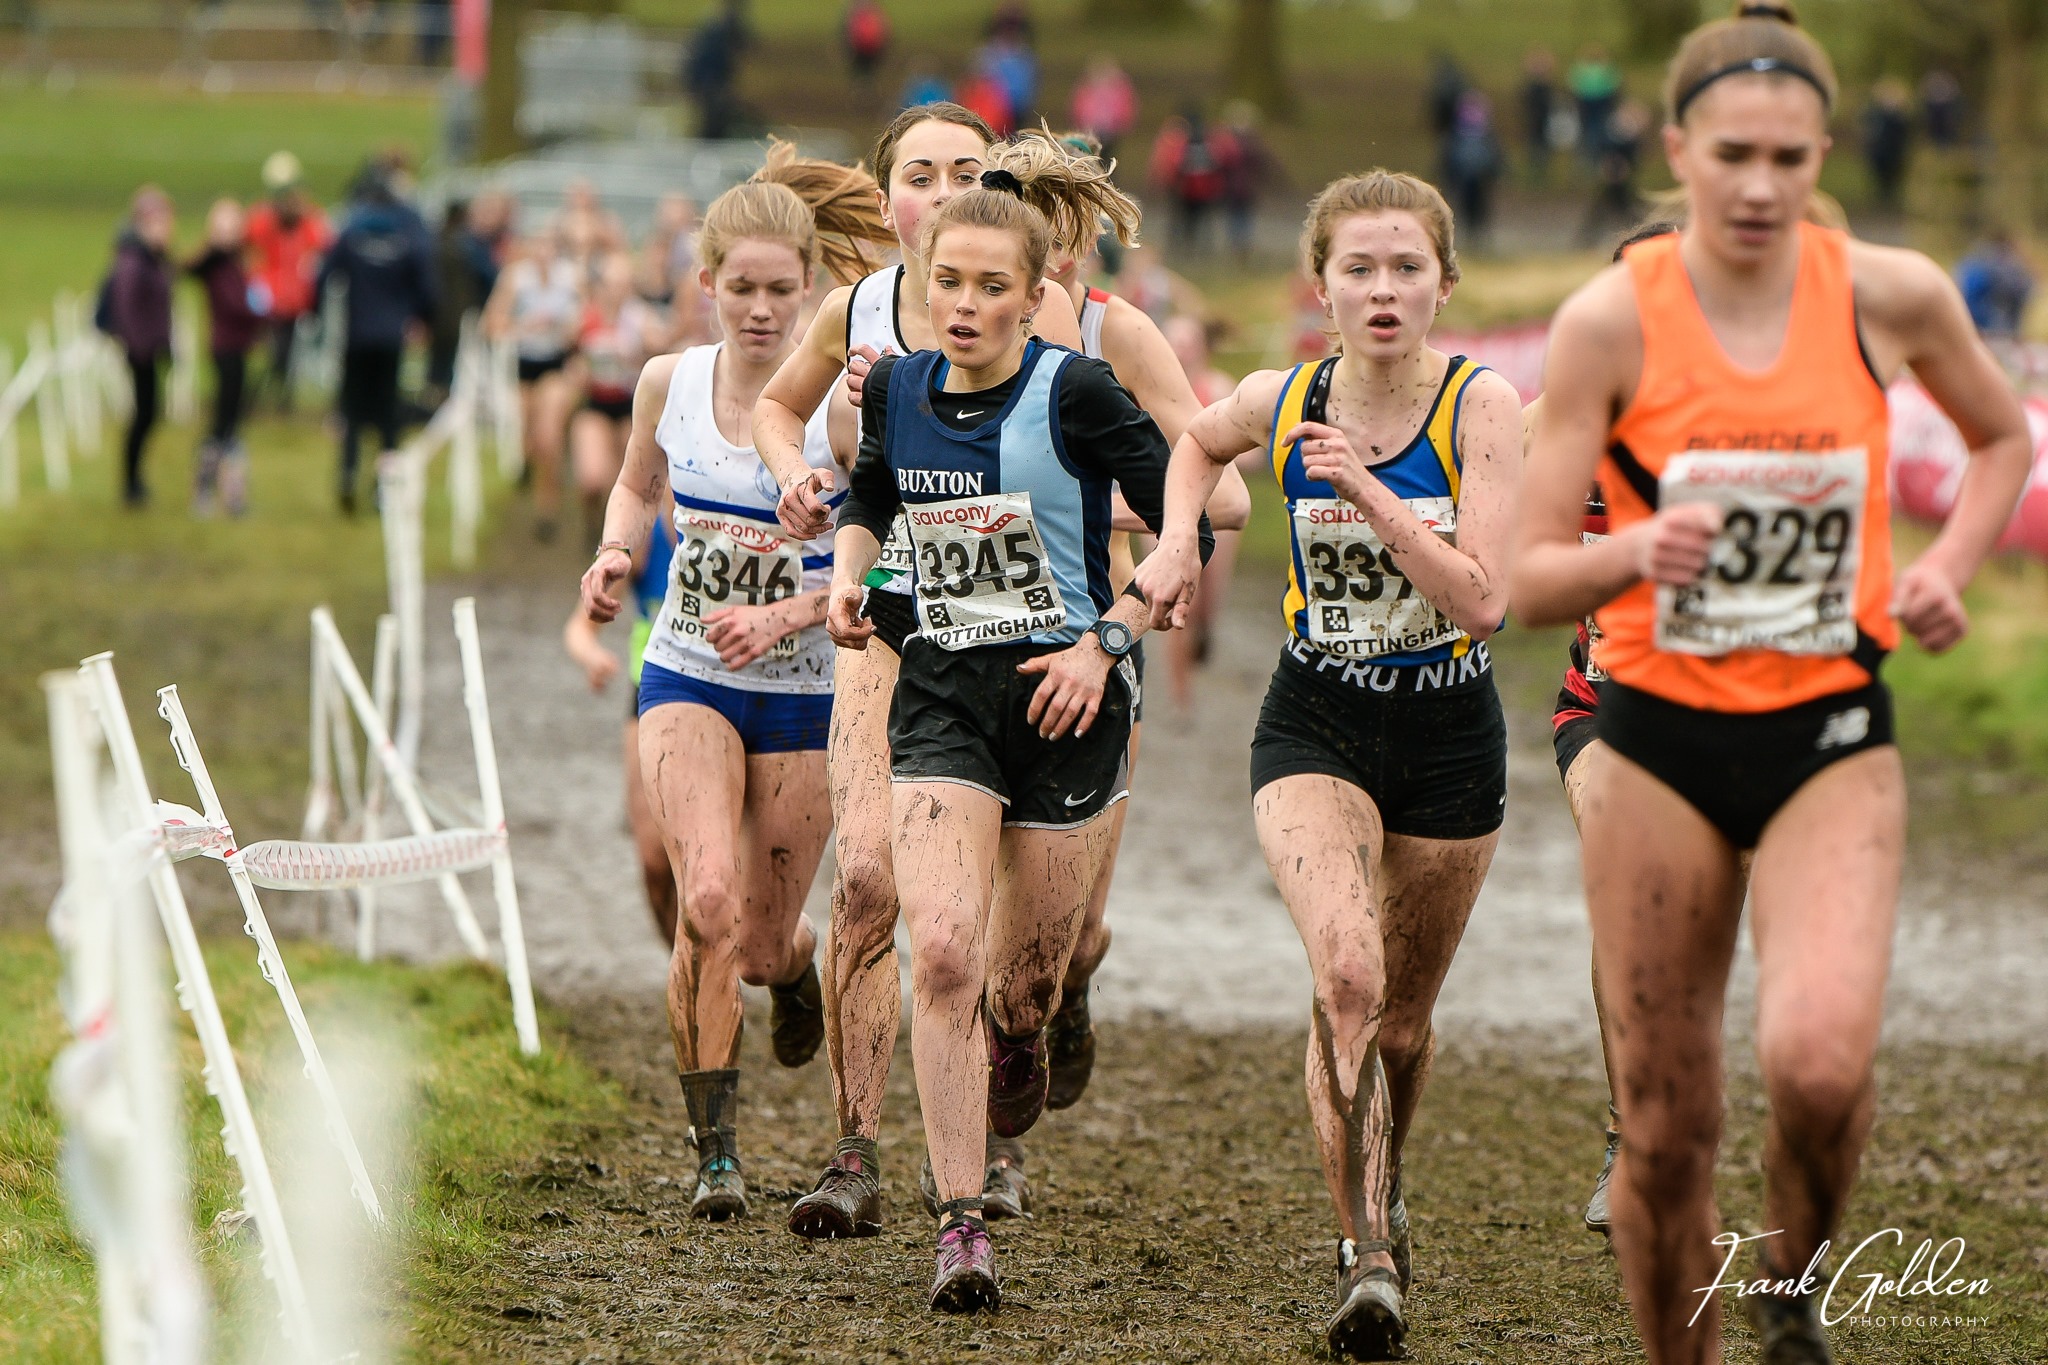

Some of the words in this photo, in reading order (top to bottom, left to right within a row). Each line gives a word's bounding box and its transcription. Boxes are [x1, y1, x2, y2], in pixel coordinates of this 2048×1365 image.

[897, 468, 983, 495] BUXTON
[688, 516, 768, 544] saucony
[912, 505, 991, 526] saucony
[1309, 508, 1367, 524] sauc
[1715, 508, 1850, 585] 329
[679, 538, 796, 606] 3346
[919, 531, 1040, 600] 3345
[1309, 542, 1414, 601] 339
[927, 613, 1062, 646] NOTTINGHAM
[1315, 619, 1455, 655] NOTTINGHA
[1316, 653, 1400, 693] PRO
[1415, 640, 1491, 693] NIKE
